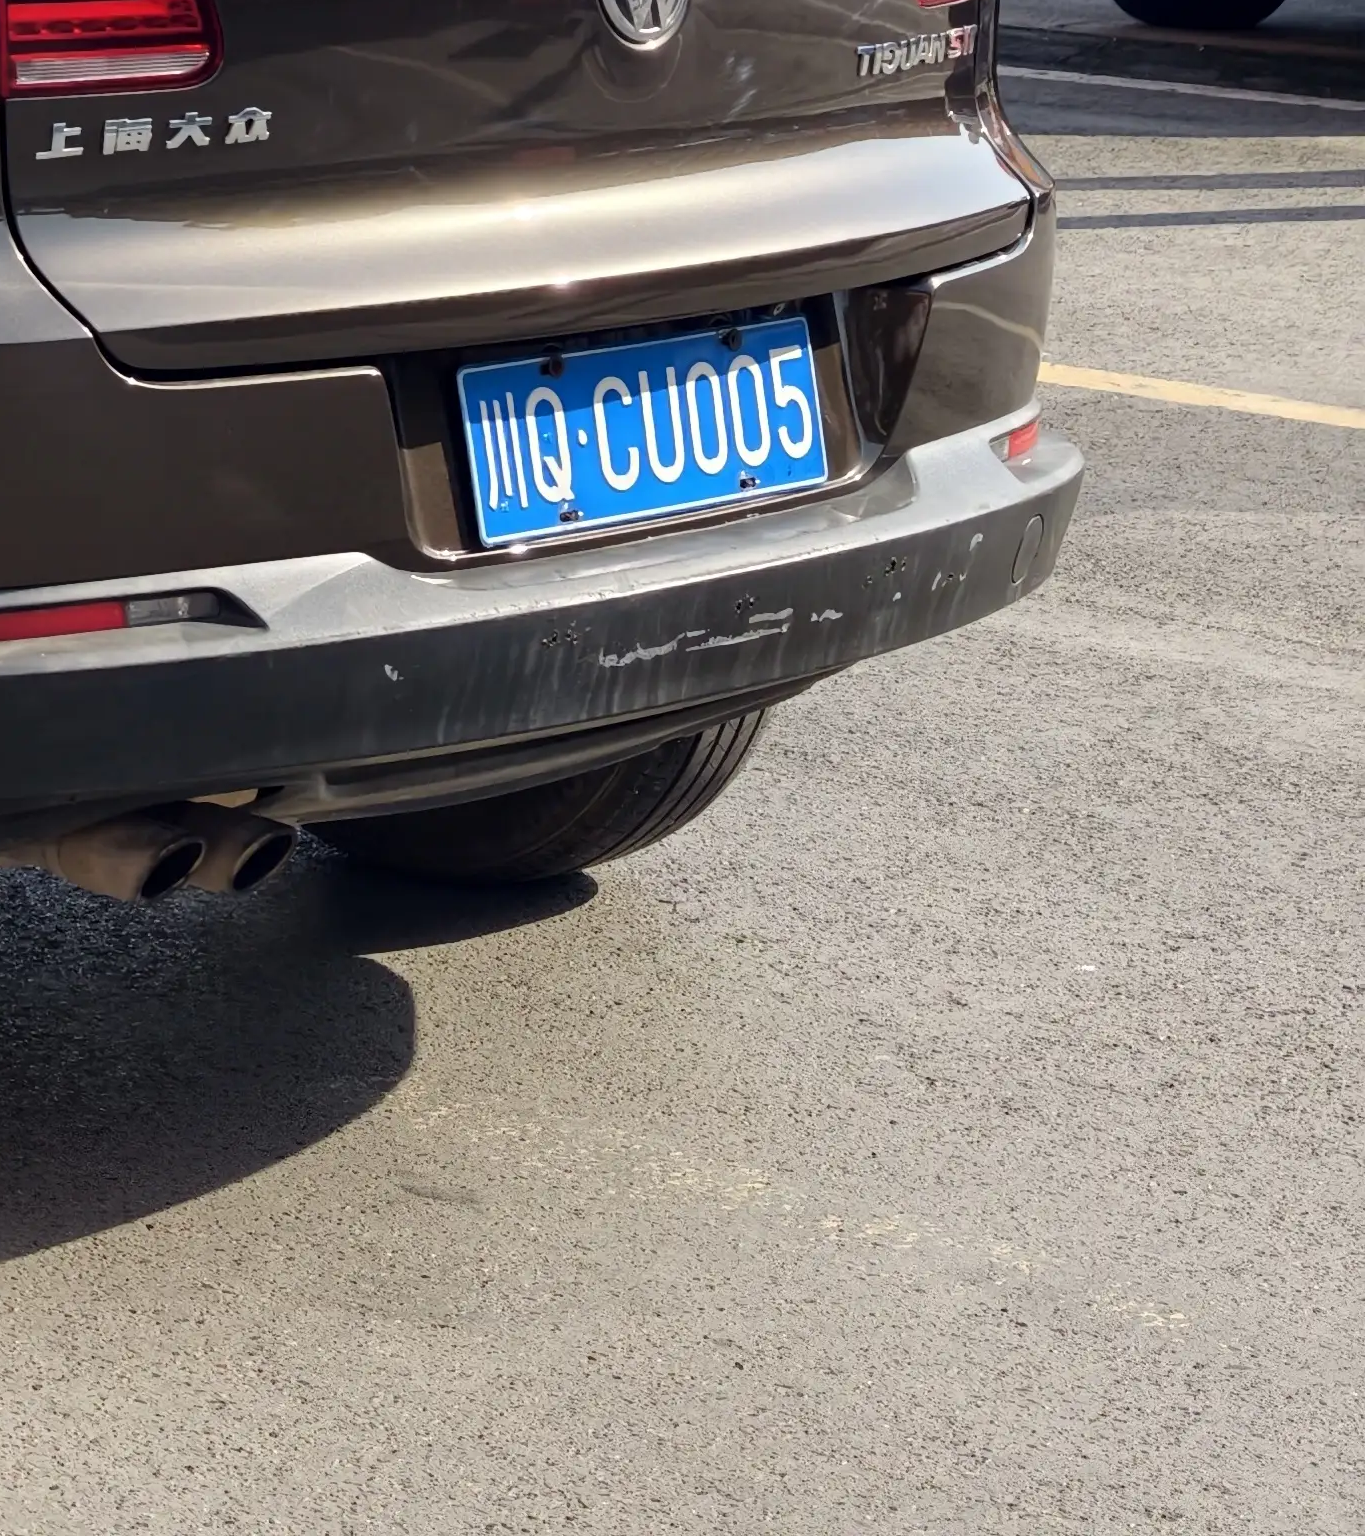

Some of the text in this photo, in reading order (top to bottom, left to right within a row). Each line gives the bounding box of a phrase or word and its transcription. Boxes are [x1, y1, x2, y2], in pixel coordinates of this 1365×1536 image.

[856, 33, 946, 76] TIGUAN
[35, 106, 273, 160] 上海大众
[479, 346, 814, 510] 川Q·CU005
